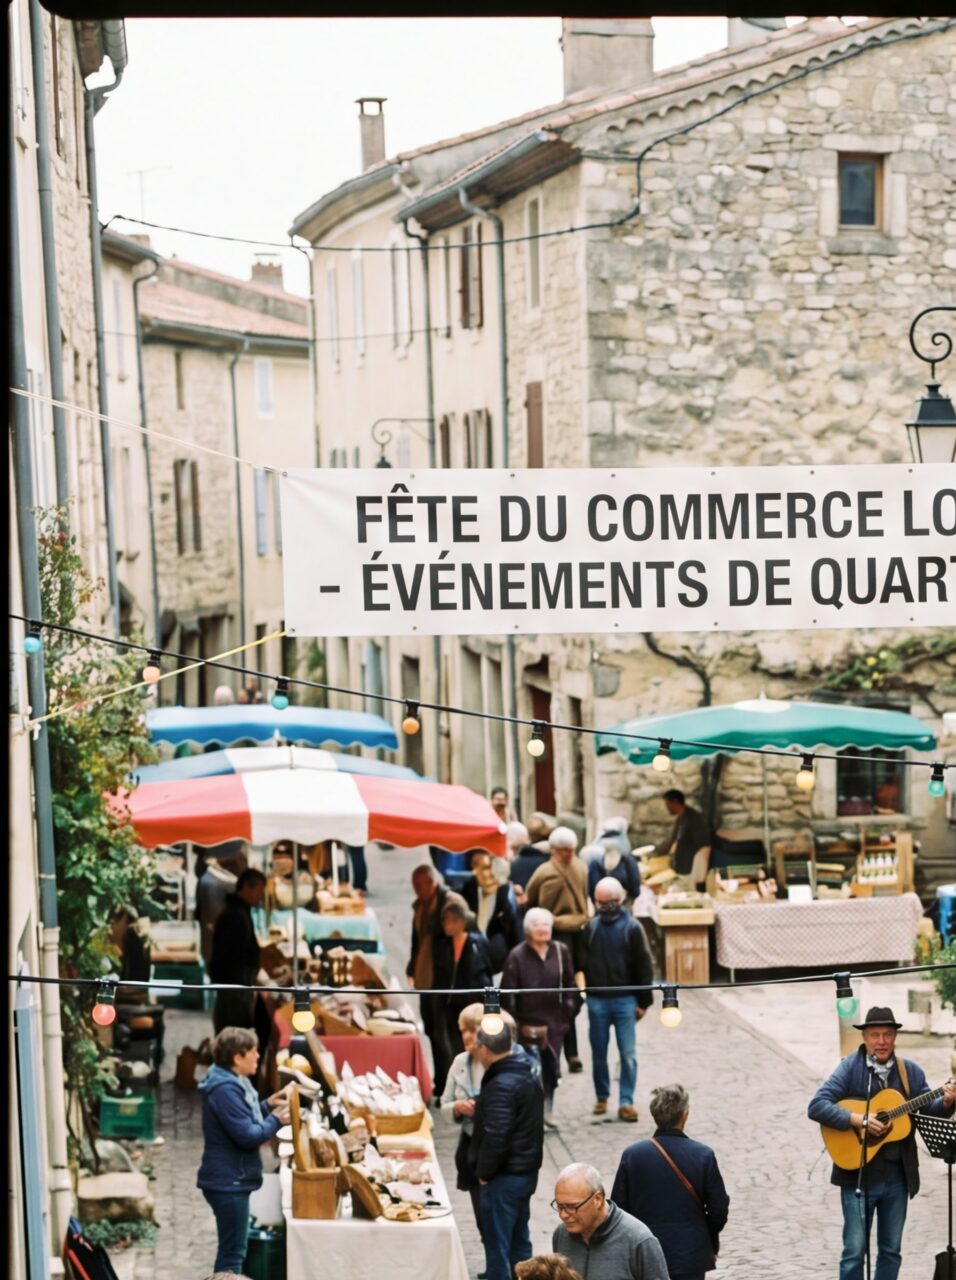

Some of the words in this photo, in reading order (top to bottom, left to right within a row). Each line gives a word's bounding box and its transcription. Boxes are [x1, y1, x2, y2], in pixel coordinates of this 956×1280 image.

[355, 483, 480, 544] FÊTE
[499, 495, 567, 543] DU
[587, 490, 885, 542] COMMERCE
[362, 550, 709, 612] ÉVÉNEMENTS
[728, 559, 792, 607] DE
